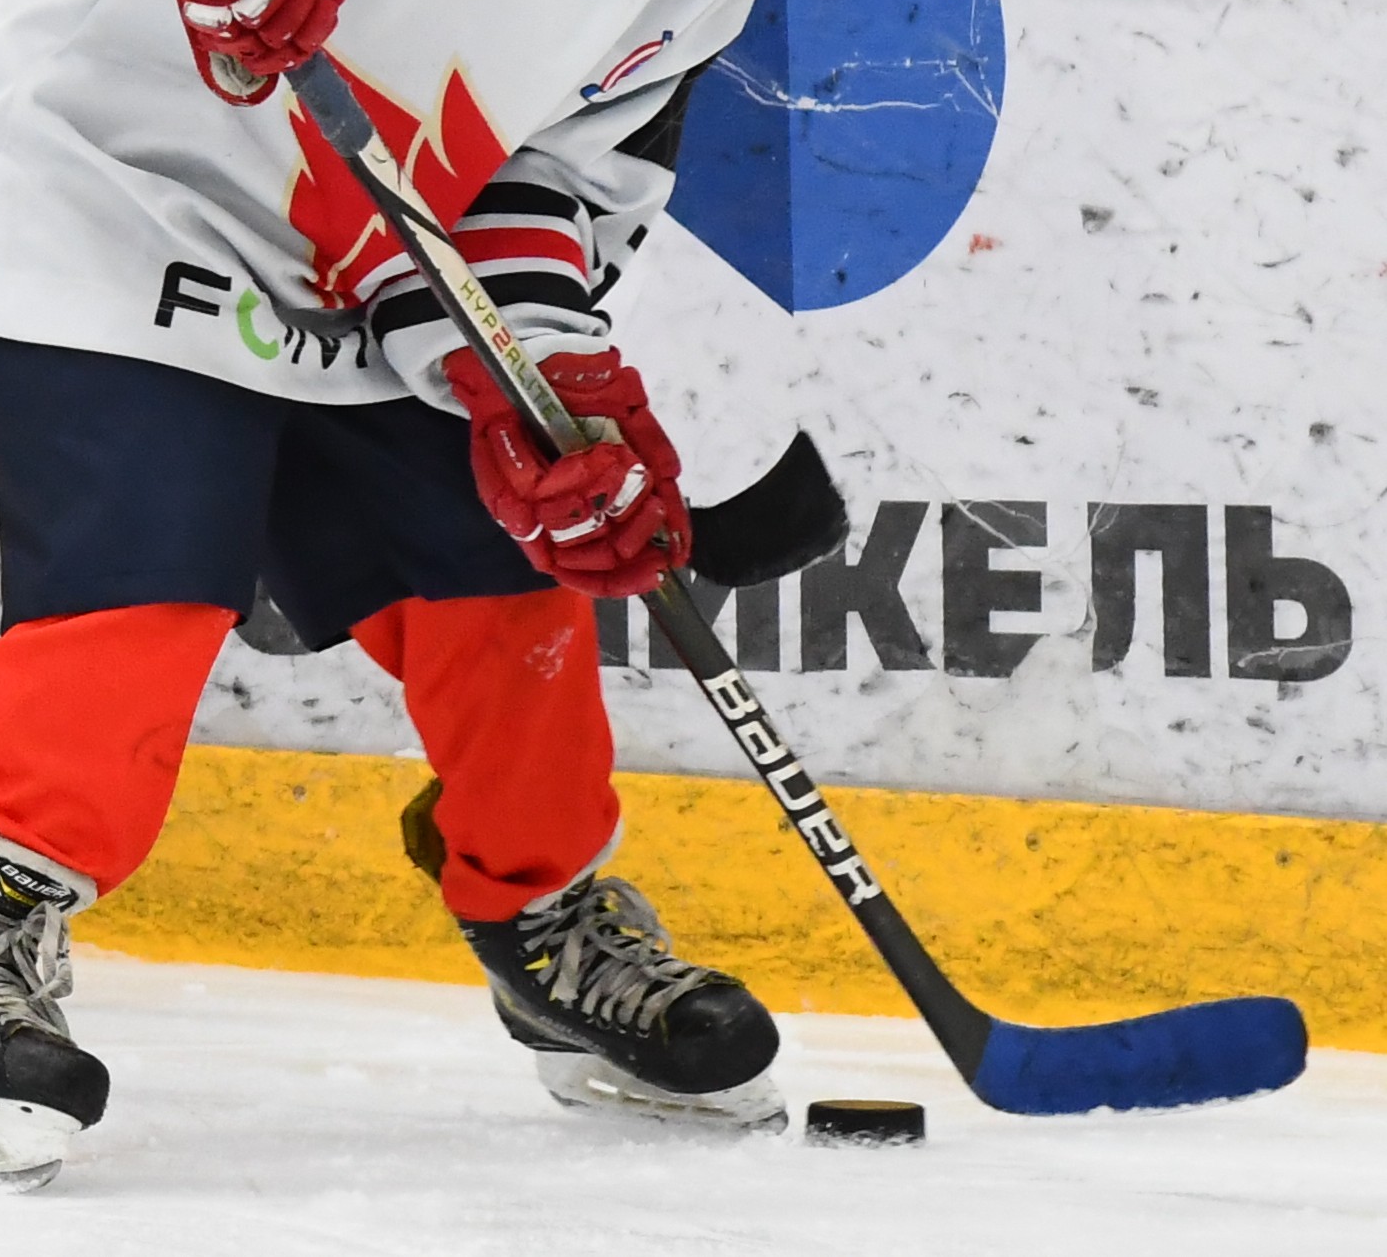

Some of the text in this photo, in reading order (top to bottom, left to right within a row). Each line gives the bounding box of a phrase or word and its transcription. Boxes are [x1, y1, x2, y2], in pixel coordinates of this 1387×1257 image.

[594, 500, 1353, 681] КЕЛЬ
[702, 668, 882, 905] BAUER
[1, 863, 72, 897] BAUER
